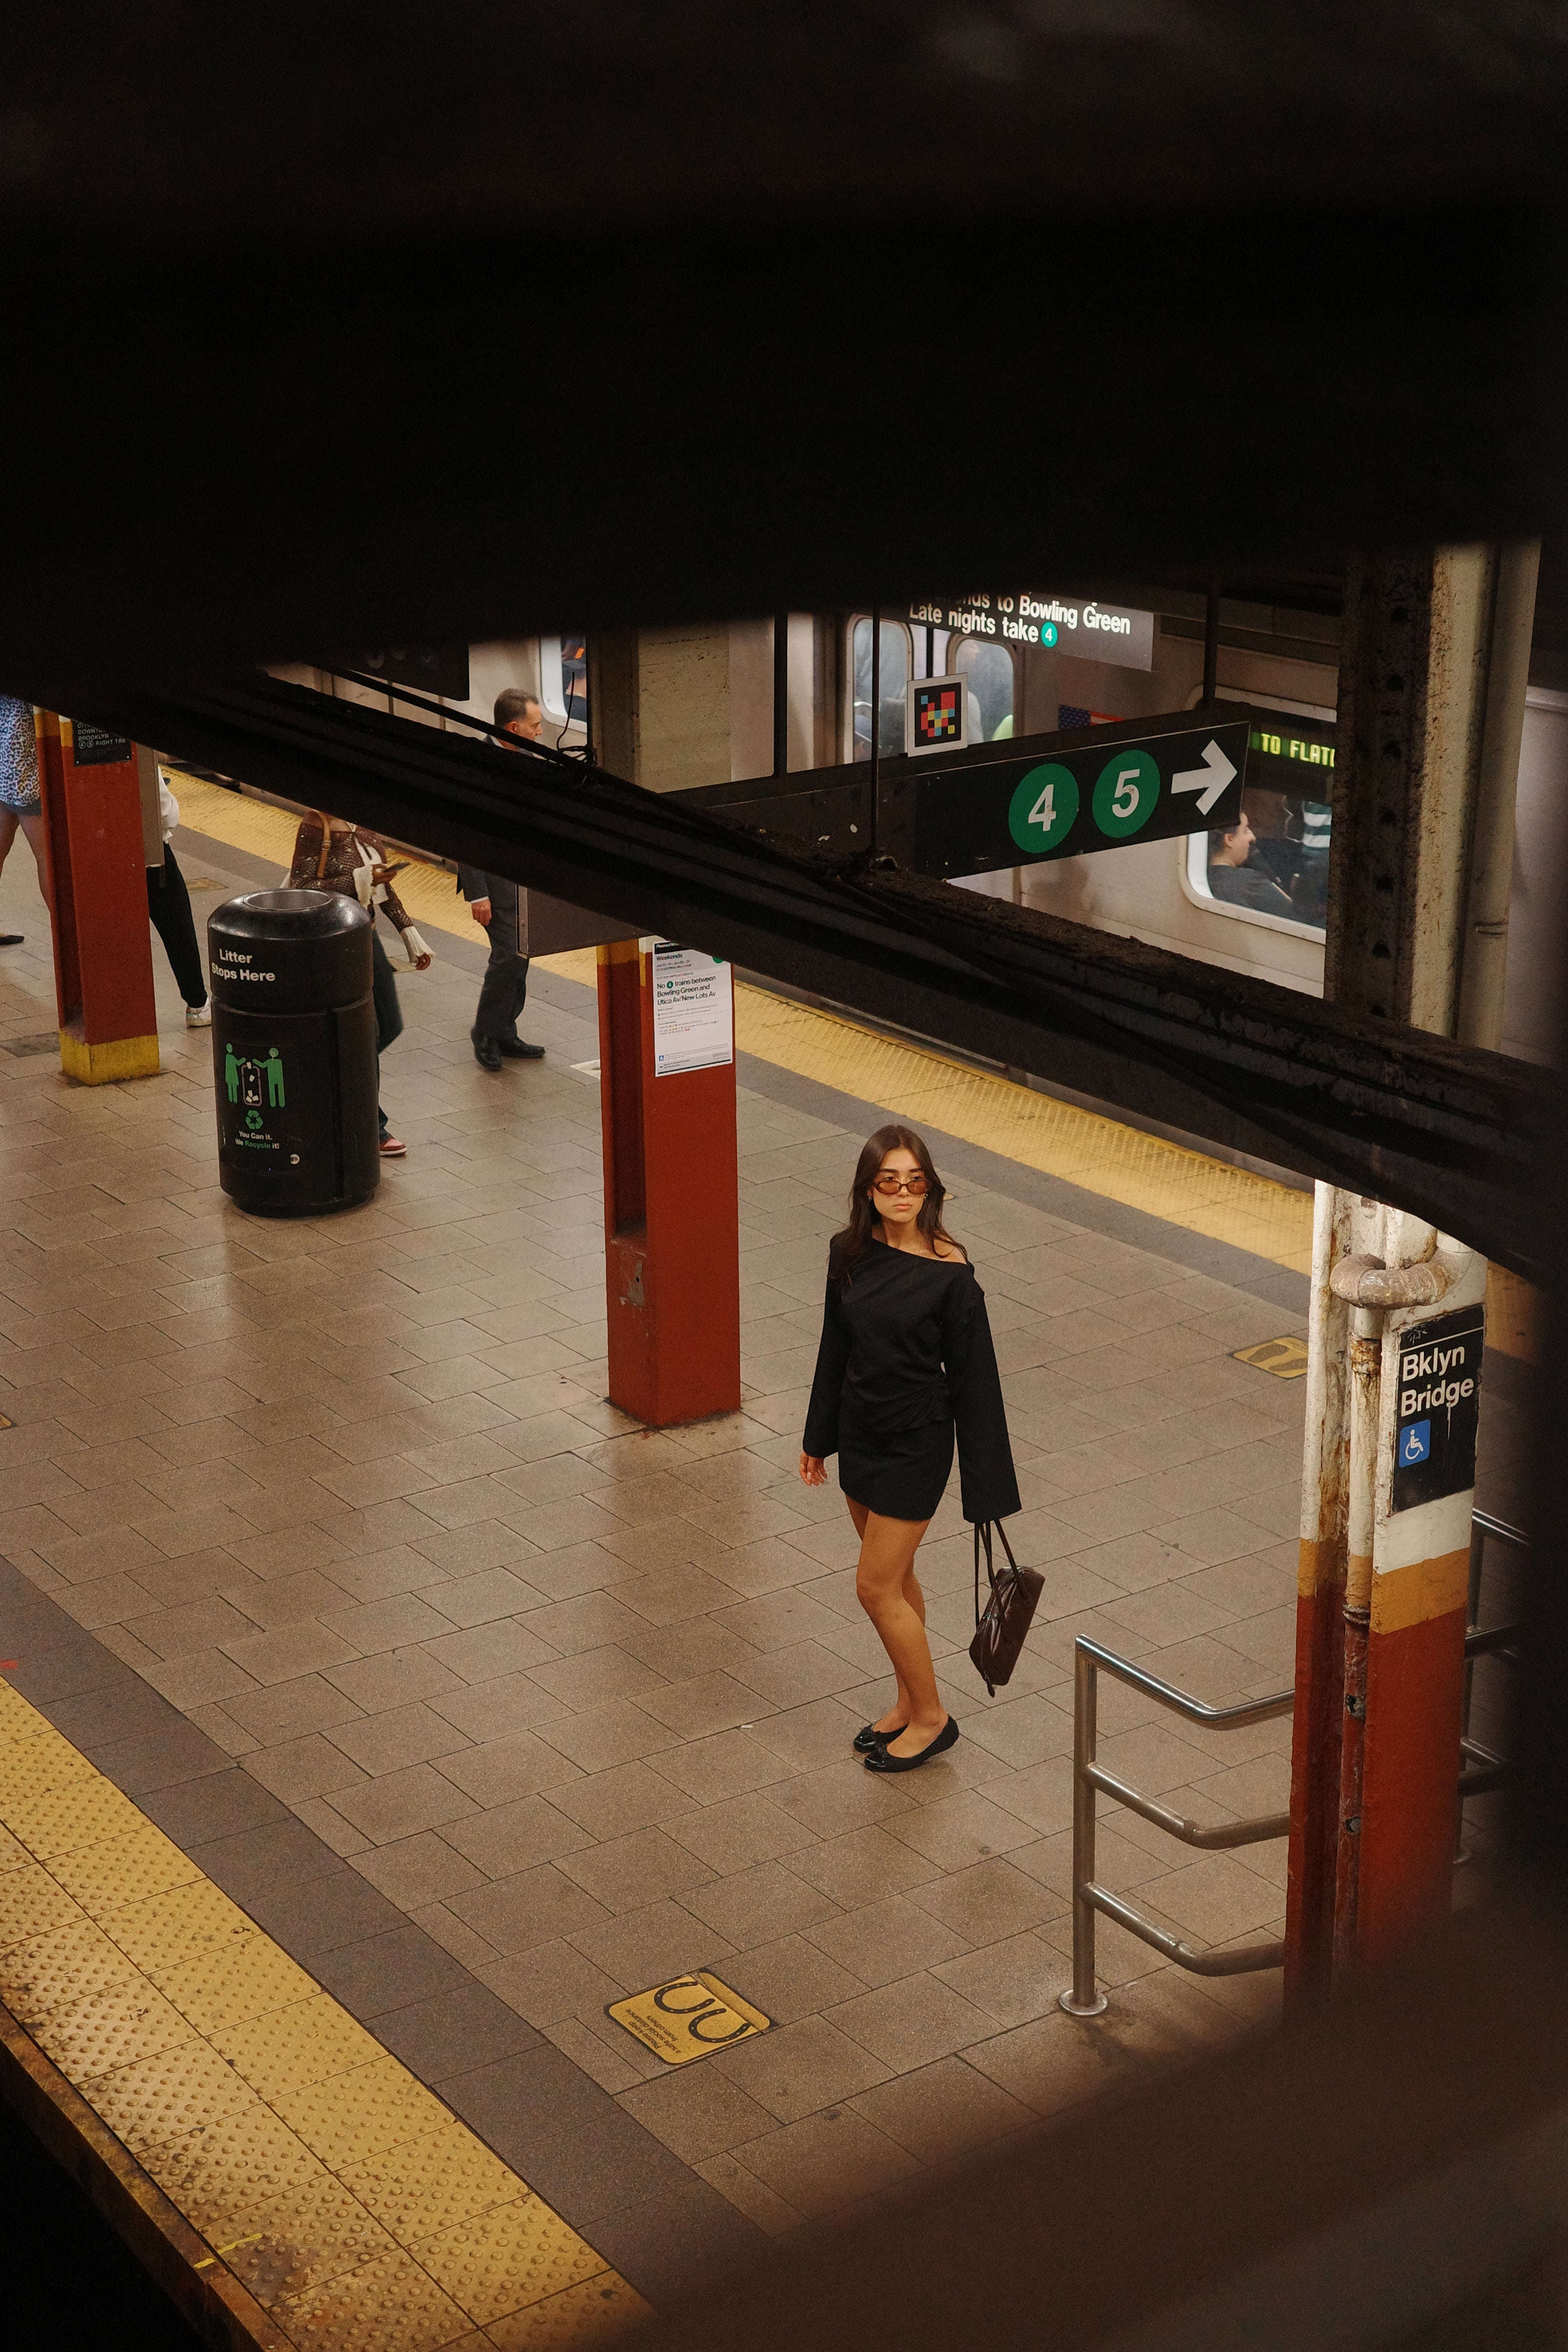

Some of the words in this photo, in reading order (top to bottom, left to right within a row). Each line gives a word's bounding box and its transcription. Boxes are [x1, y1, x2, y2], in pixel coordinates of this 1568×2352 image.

[997, 593, 1014, 613] to
[1019, 595, 1078, 629] Bowling
[1083, 606, 1130, 635] Green
[909, 603, 943, 624] Late
[948, 608, 996, 634] nights
[1002, 616, 1039, 642] take
[78, 733, 109, 741] BROOKLYN
[1261, 733, 1281, 755] TO
[1028, 784, 1056, 832] 4
[1112, 769, 1140, 818] 5
[220, 948, 252, 964] Litter
[211, 962, 238, 980] Stops
[240, 969, 276, 981] Here
[658, 989, 680, 998] Bowling
[245, 1140, 270, 1149] Recycle
[1402, 1346, 1465, 1382] Bklyn
[1401, 1377, 1474, 1417] Bridge
[626, 2009, 649, 2028] distance
[646, 2015, 665, 2030] others
[629, 2022, 644, 2034] keep
[645, 2027, 665, 2041] social
[663, 2029, 679, 2041] from
[642, 2033, 662, 2049] Please
[664, 2040, 677, 2051] safe
